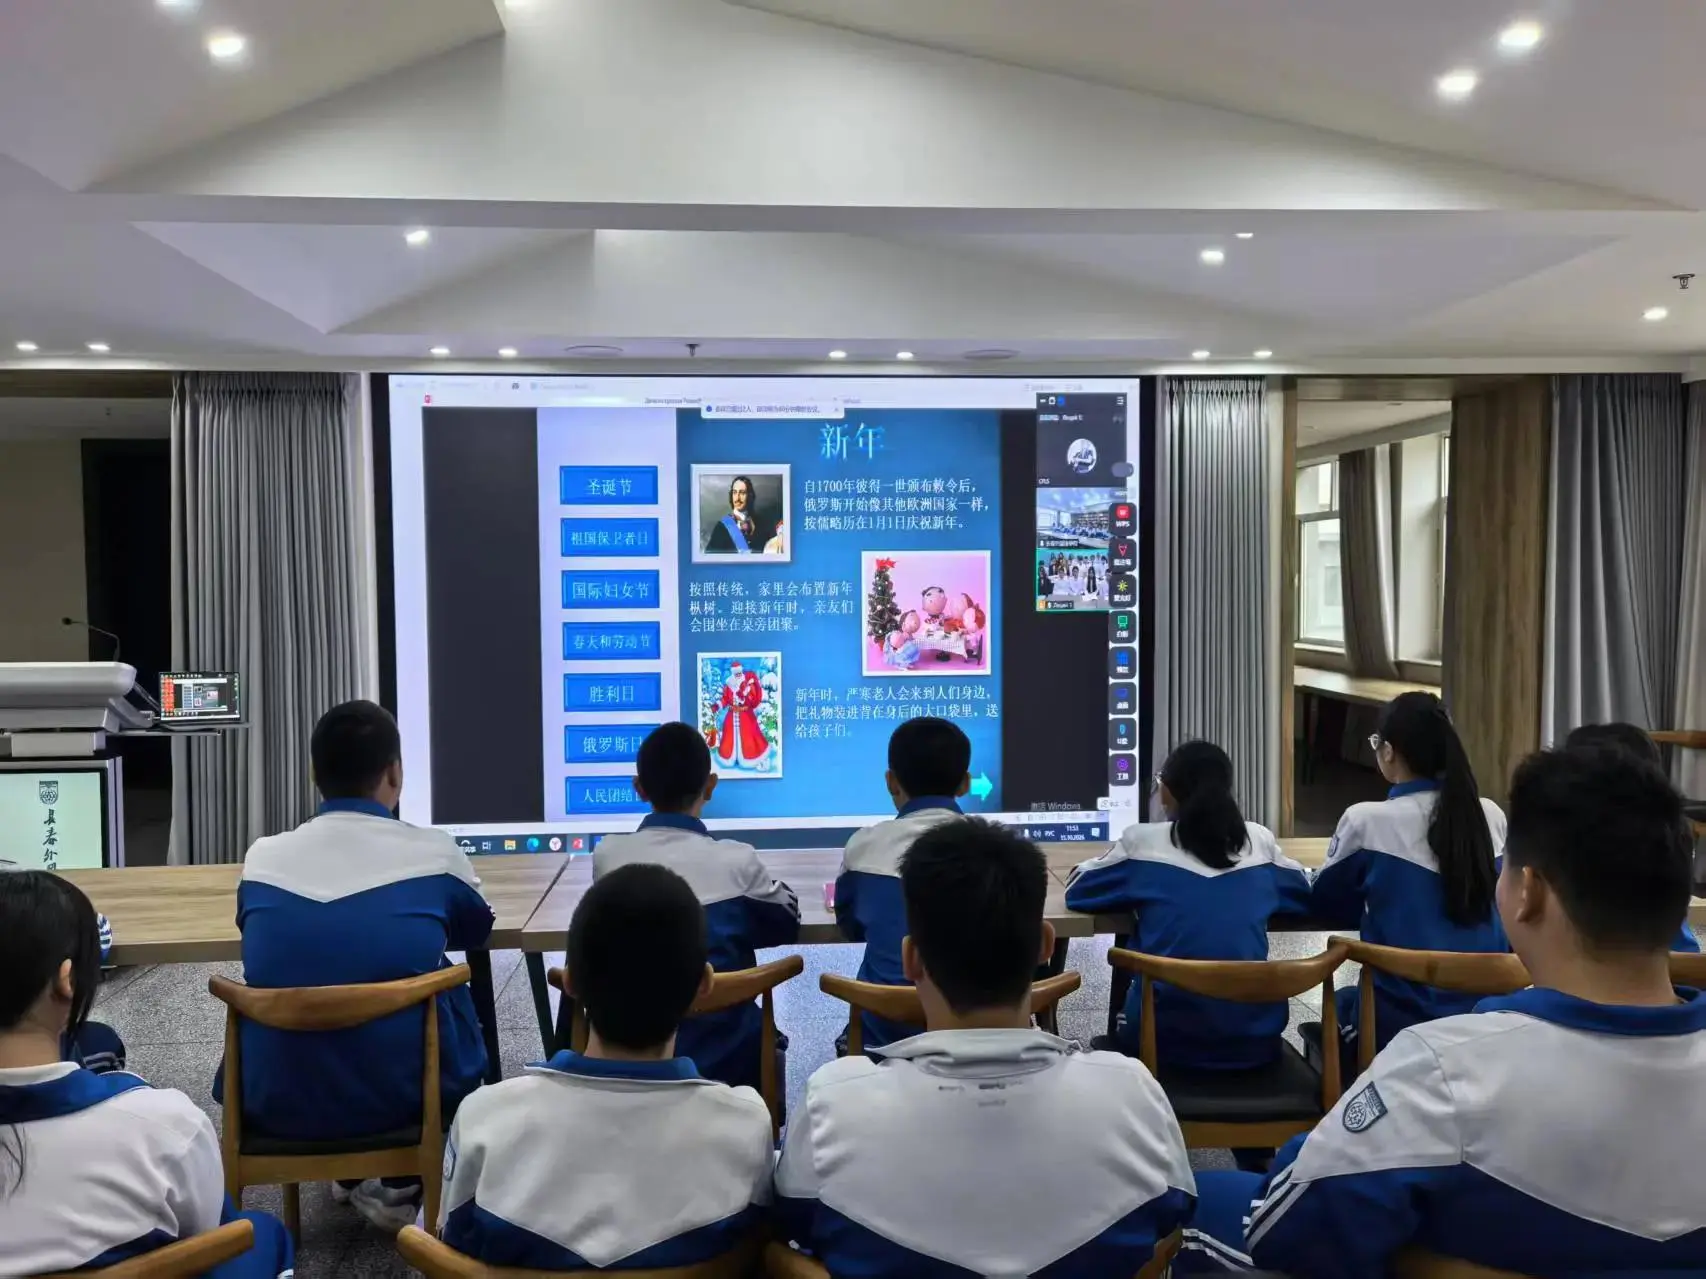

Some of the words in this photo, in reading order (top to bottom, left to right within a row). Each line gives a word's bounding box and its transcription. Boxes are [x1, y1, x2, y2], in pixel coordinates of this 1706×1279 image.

[819, 423, 885, 461] 新年
[586, 478, 632, 496] 圣诞节
[571, 531, 648, 546] 祖国保卫者日
[572, 581, 649, 599] 国际妇女节
[574, 632, 651, 649] 春天和劳动节
[589, 686, 634, 703] 胜利日
[583, 736, 642, 754] 俄罗斯日
[1047, 802, 1081, 811] Windows
